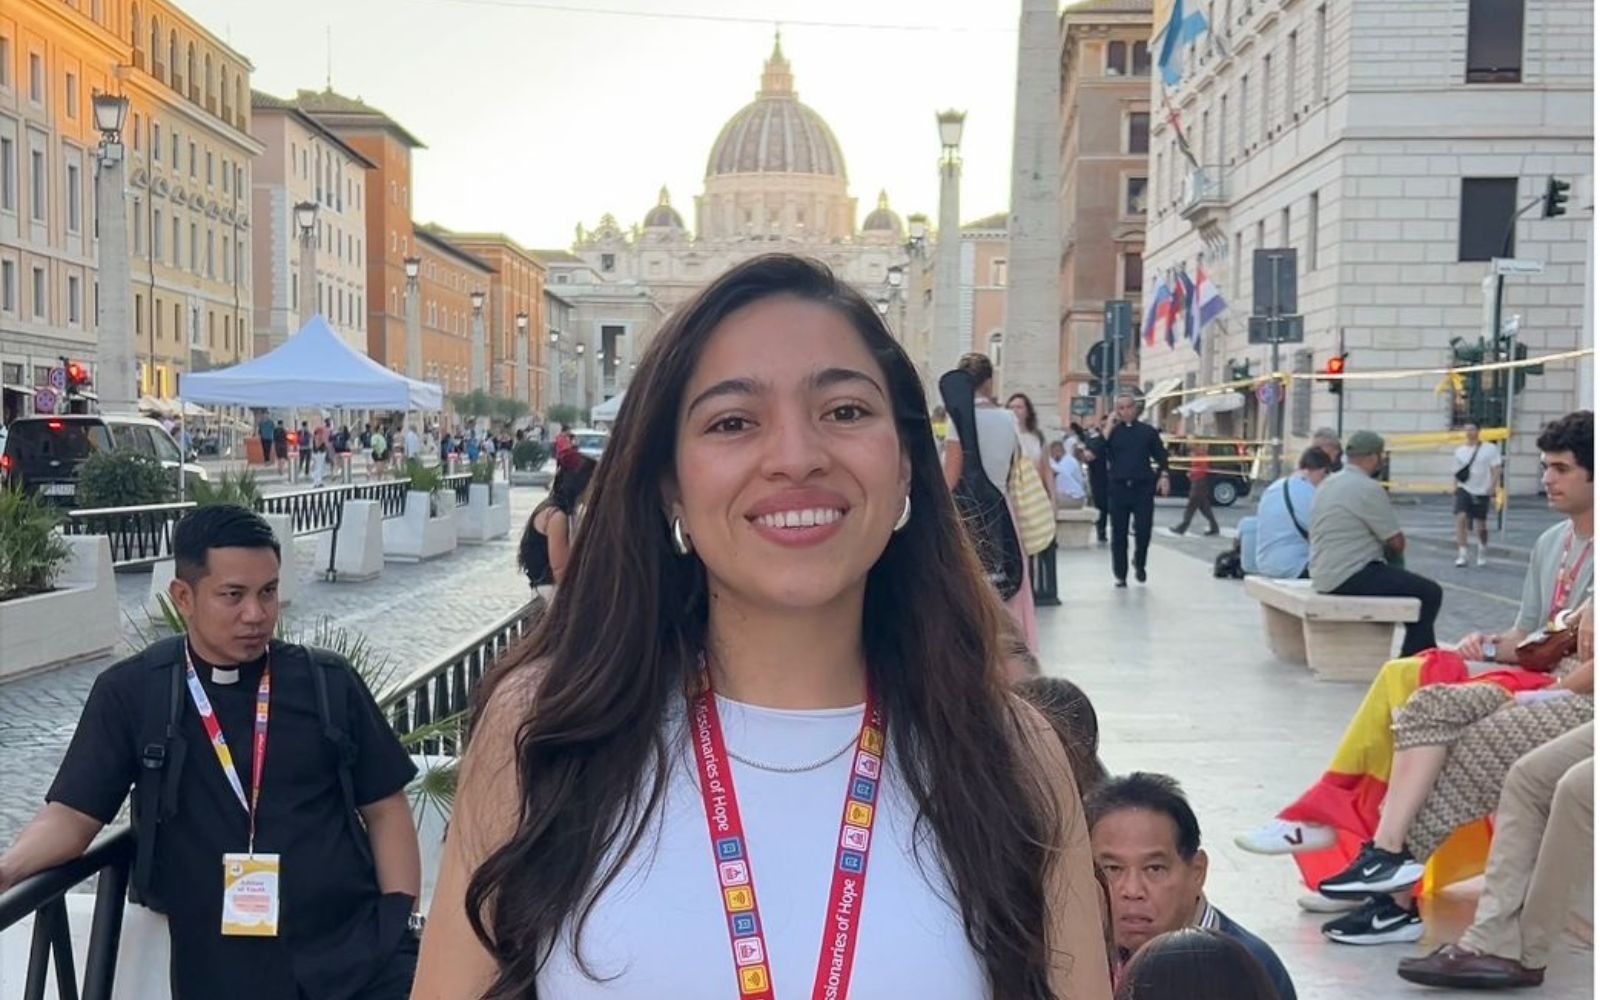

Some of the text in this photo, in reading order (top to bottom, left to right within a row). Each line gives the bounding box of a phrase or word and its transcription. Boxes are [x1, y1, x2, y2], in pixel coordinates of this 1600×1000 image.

[710, 780, 726, 793] of
[712, 795, 729, 832] Hope
[838, 878, 858, 914] Hope
[835, 914, 850, 931] of
